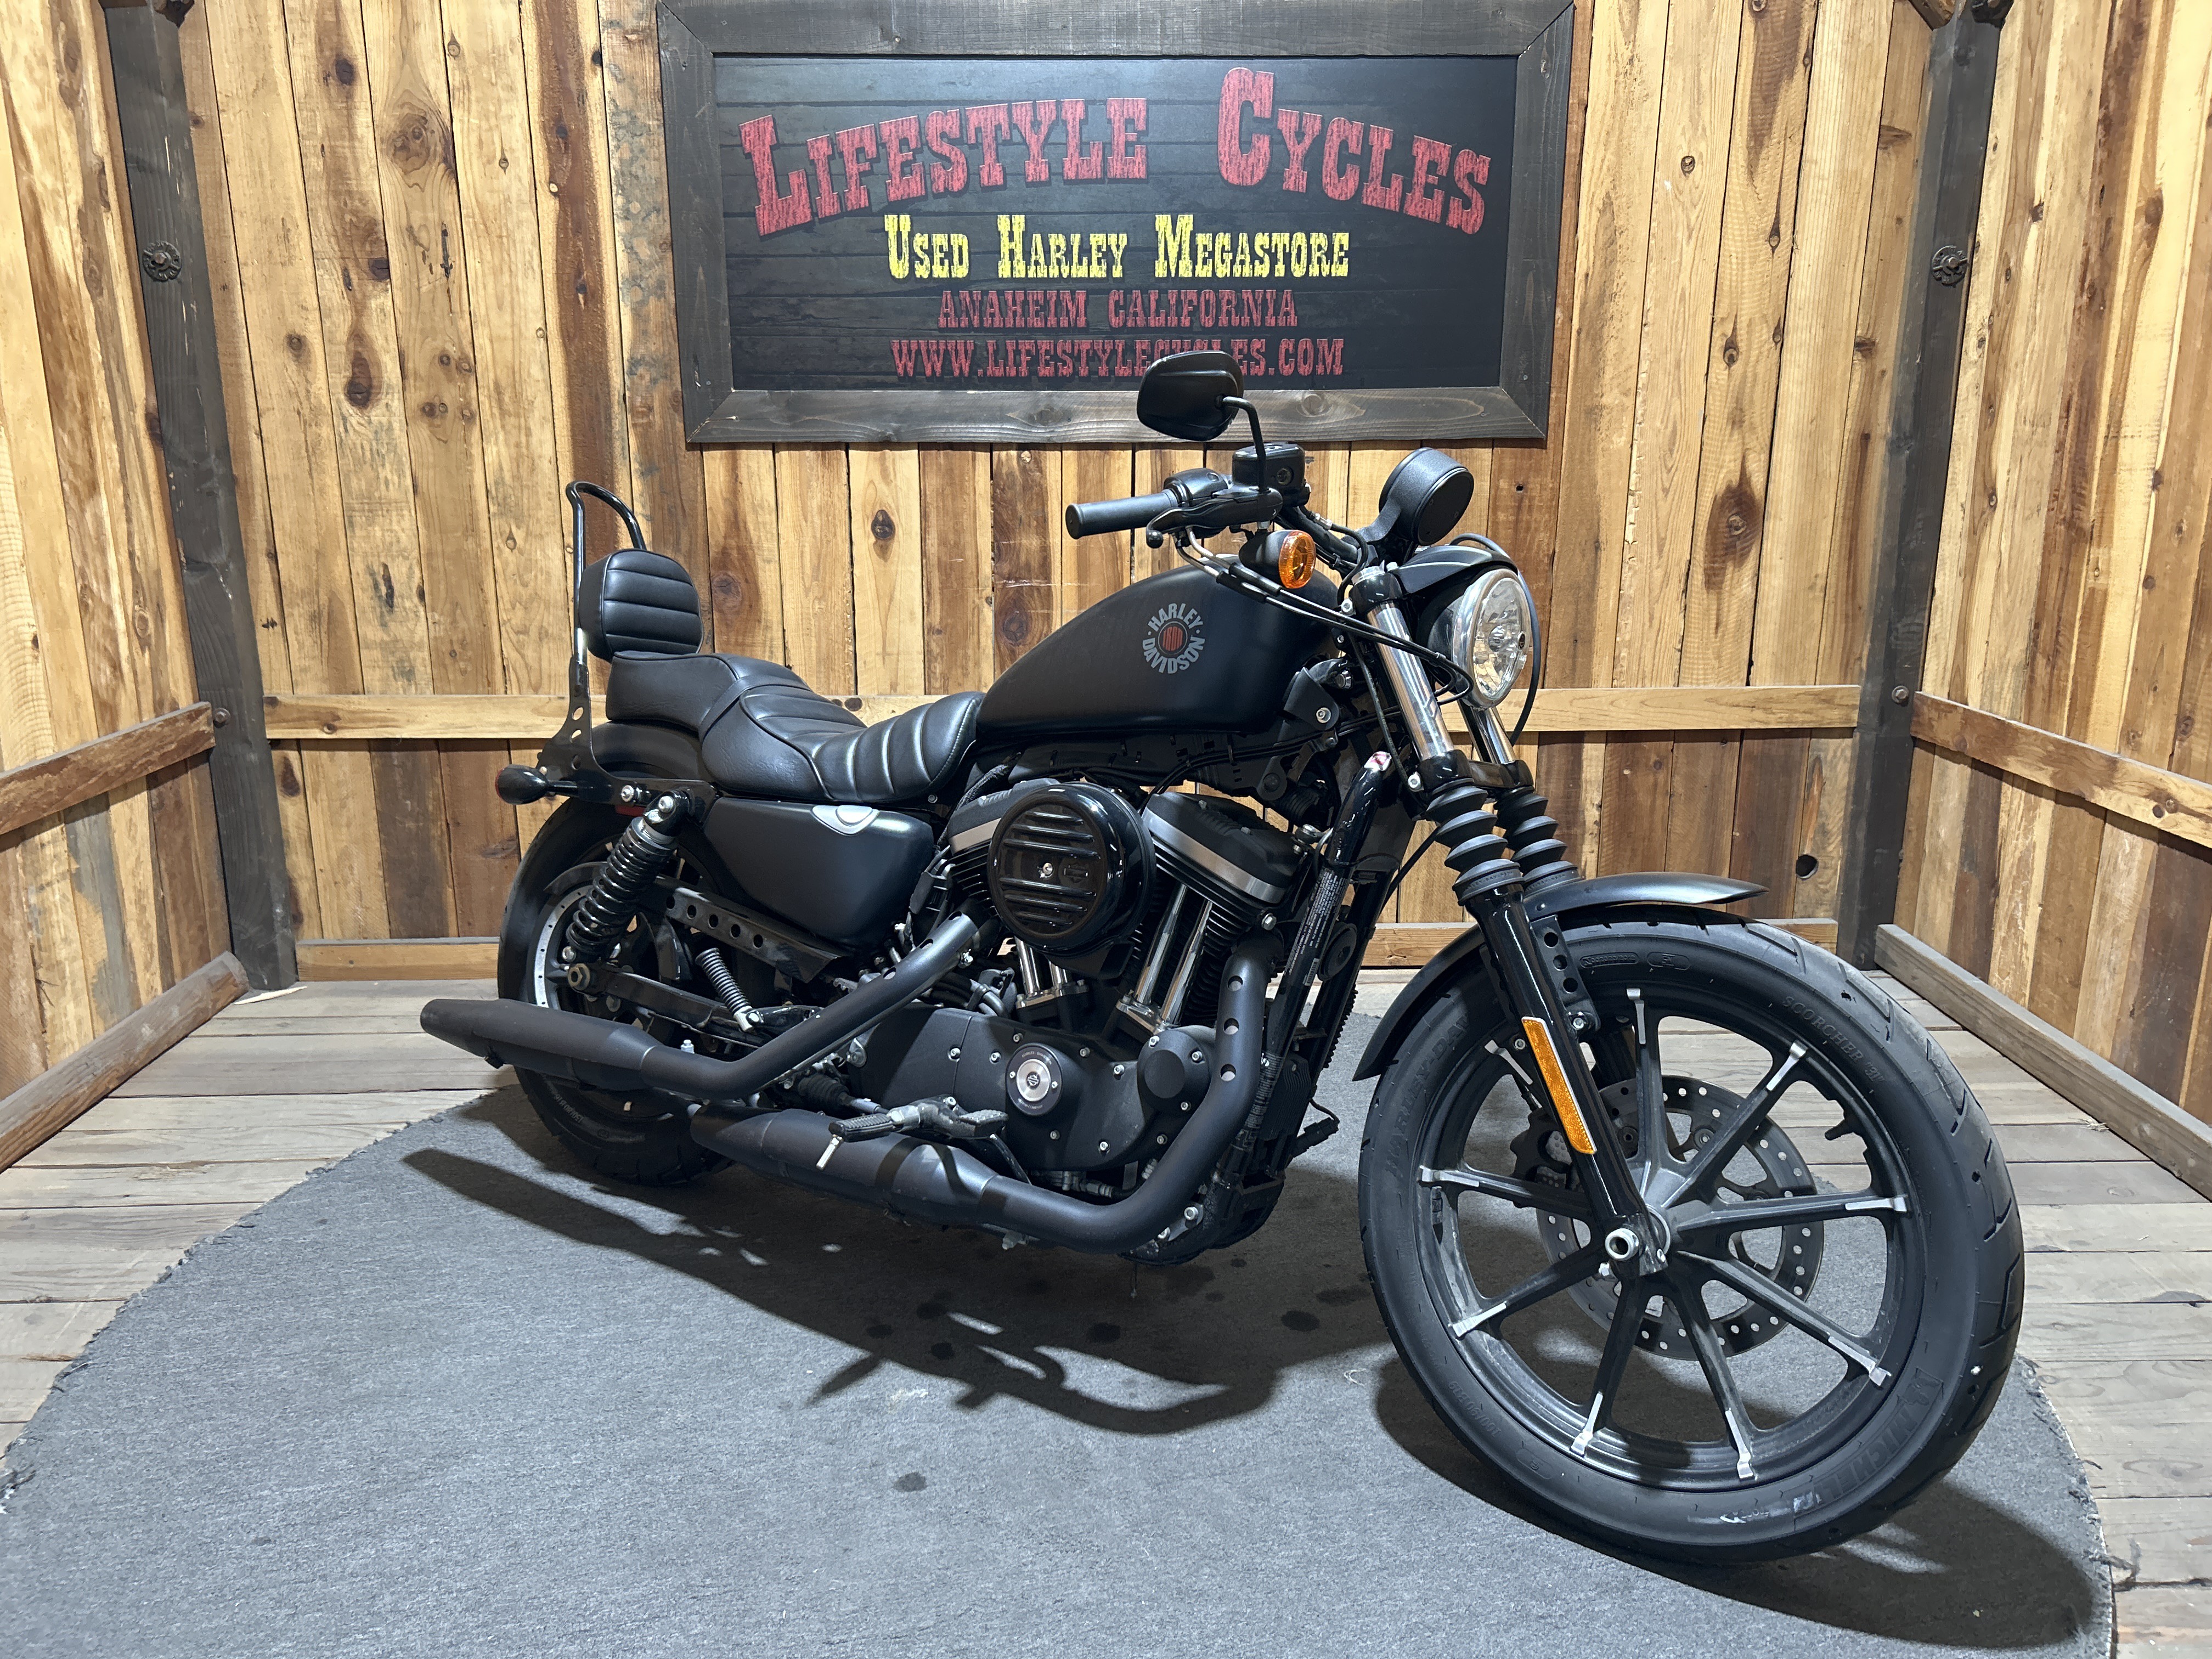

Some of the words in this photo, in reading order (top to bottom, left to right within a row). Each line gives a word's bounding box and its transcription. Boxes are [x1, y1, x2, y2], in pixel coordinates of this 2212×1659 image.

[738, 98, 1148, 236] LIFESTYLE
[1217, 67, 1491, 235] CYCLES
[884, 214, 969, 279] USED
[997, 214, 1128, 279] HARLEY
[1154, 214, 1350, 278] MEGASTORE
[939, 290, 1087, 328] ANAHEIM
[1108, 290, 1298, 328] CALIFORNIA
[1148, 603, 1204, 632] HARLEY
[1142, 636, 1206, 674] DAVIDSON
[1781, 996, 1864, 1063] SCORCHER
